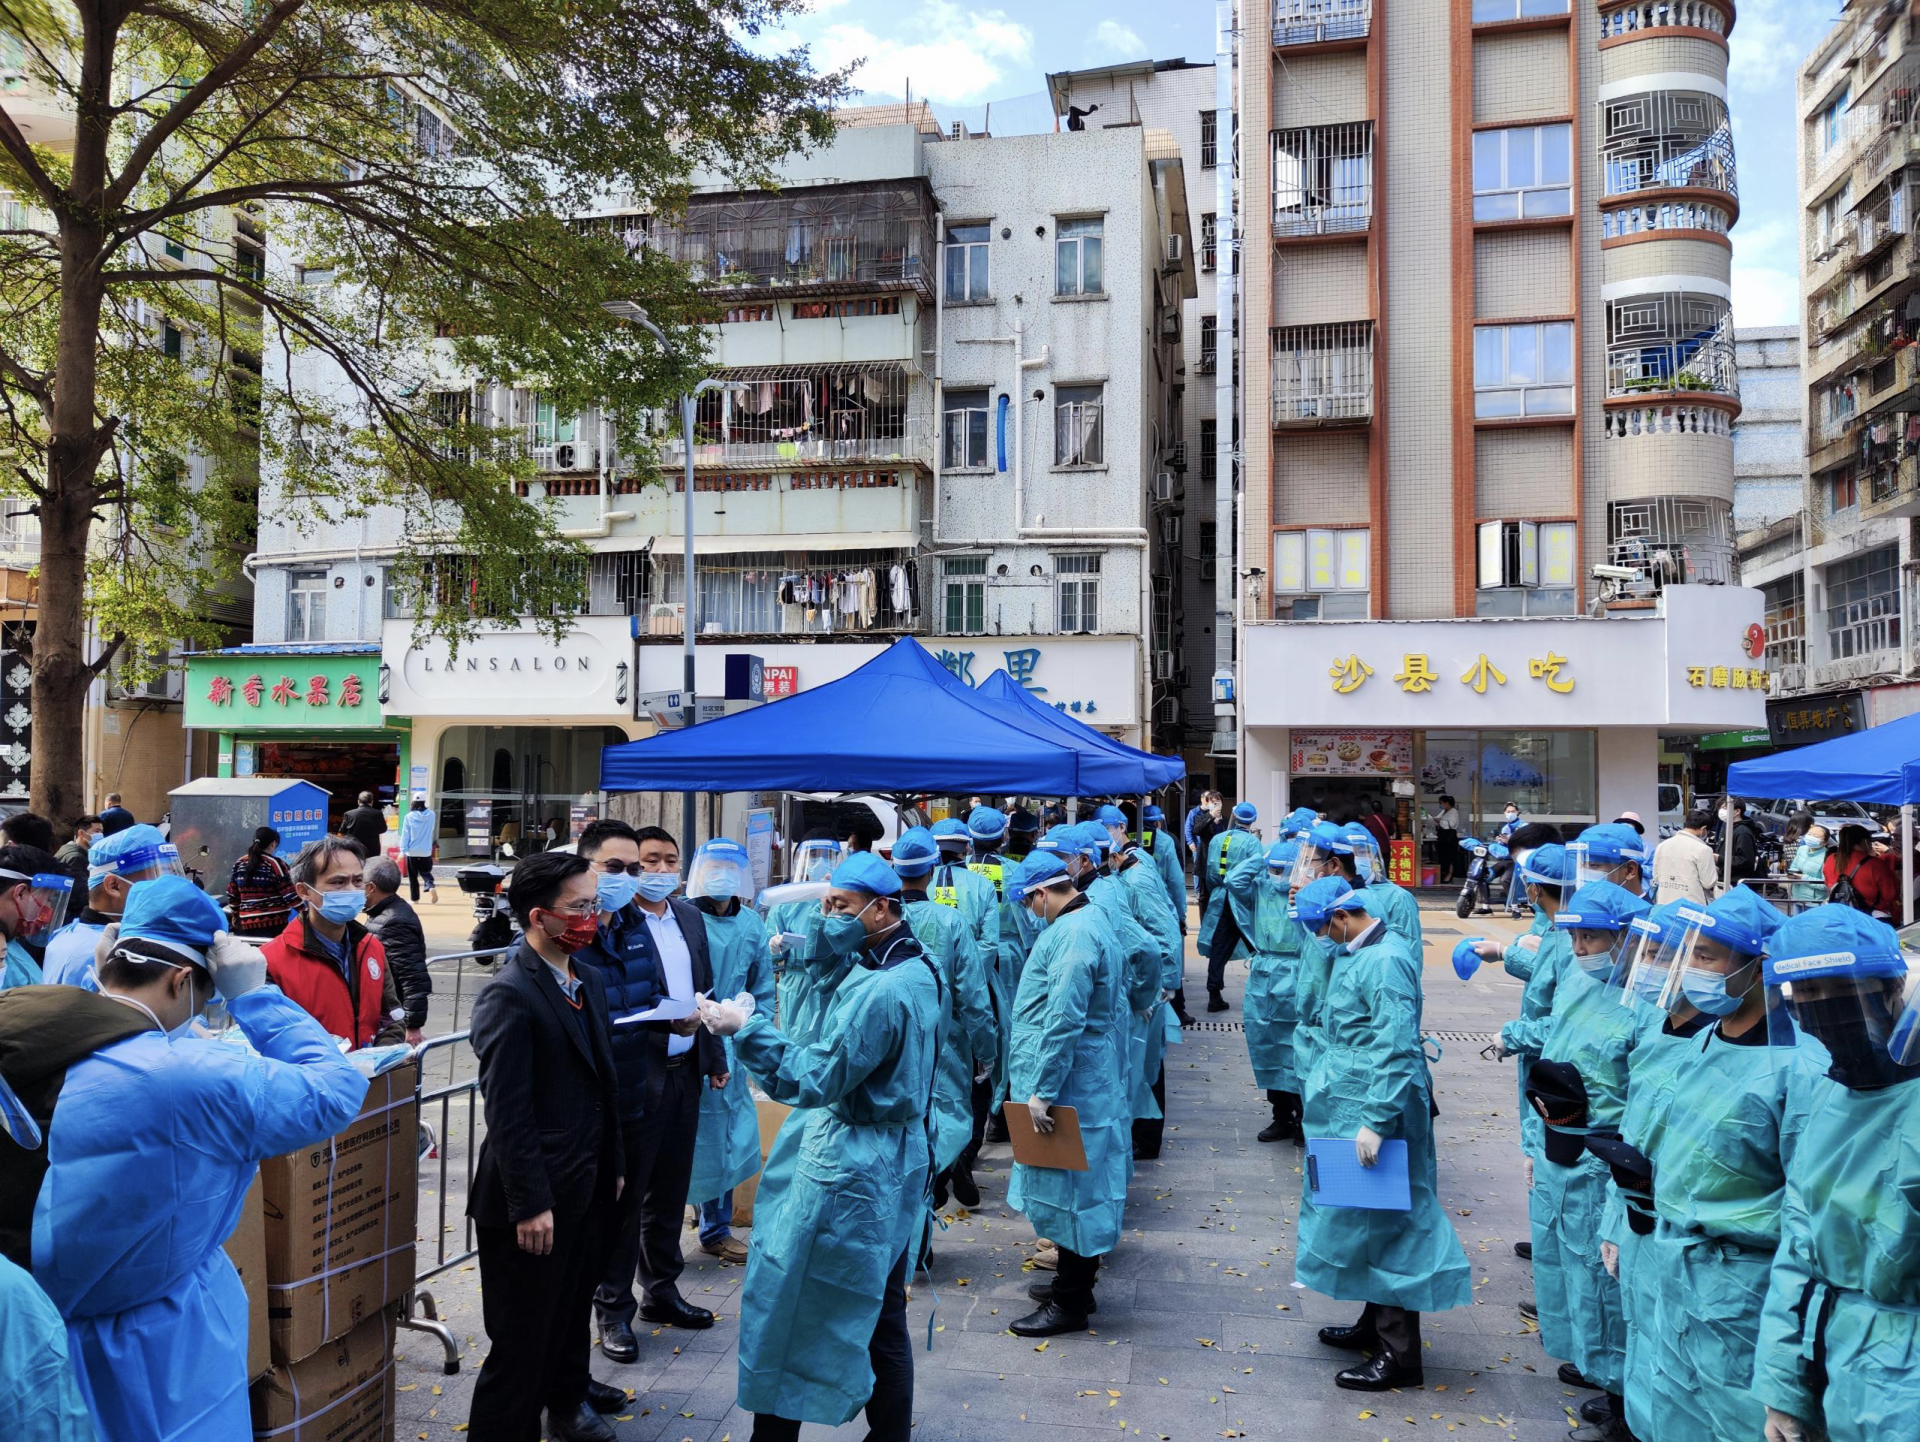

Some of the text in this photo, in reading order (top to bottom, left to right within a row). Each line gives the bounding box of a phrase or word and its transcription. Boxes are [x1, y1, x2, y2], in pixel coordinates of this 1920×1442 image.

[424, 656, 590, 672] LANSALON
[1328, 651, 1576, 694] 沙县小吃
[207, 673, 362, 707] 新香水果店
[763, 681, 790, 693] 男装
[1399, 845, 1412, 882] 木桶饭
[1776, 961, 1800, 972] Medical
[1803, 958, 1822, 967] Face
[1824, 954, 1852, 964] Shield
[322, 1119, 400, 1158] 河共泰医疗科技有限公司
